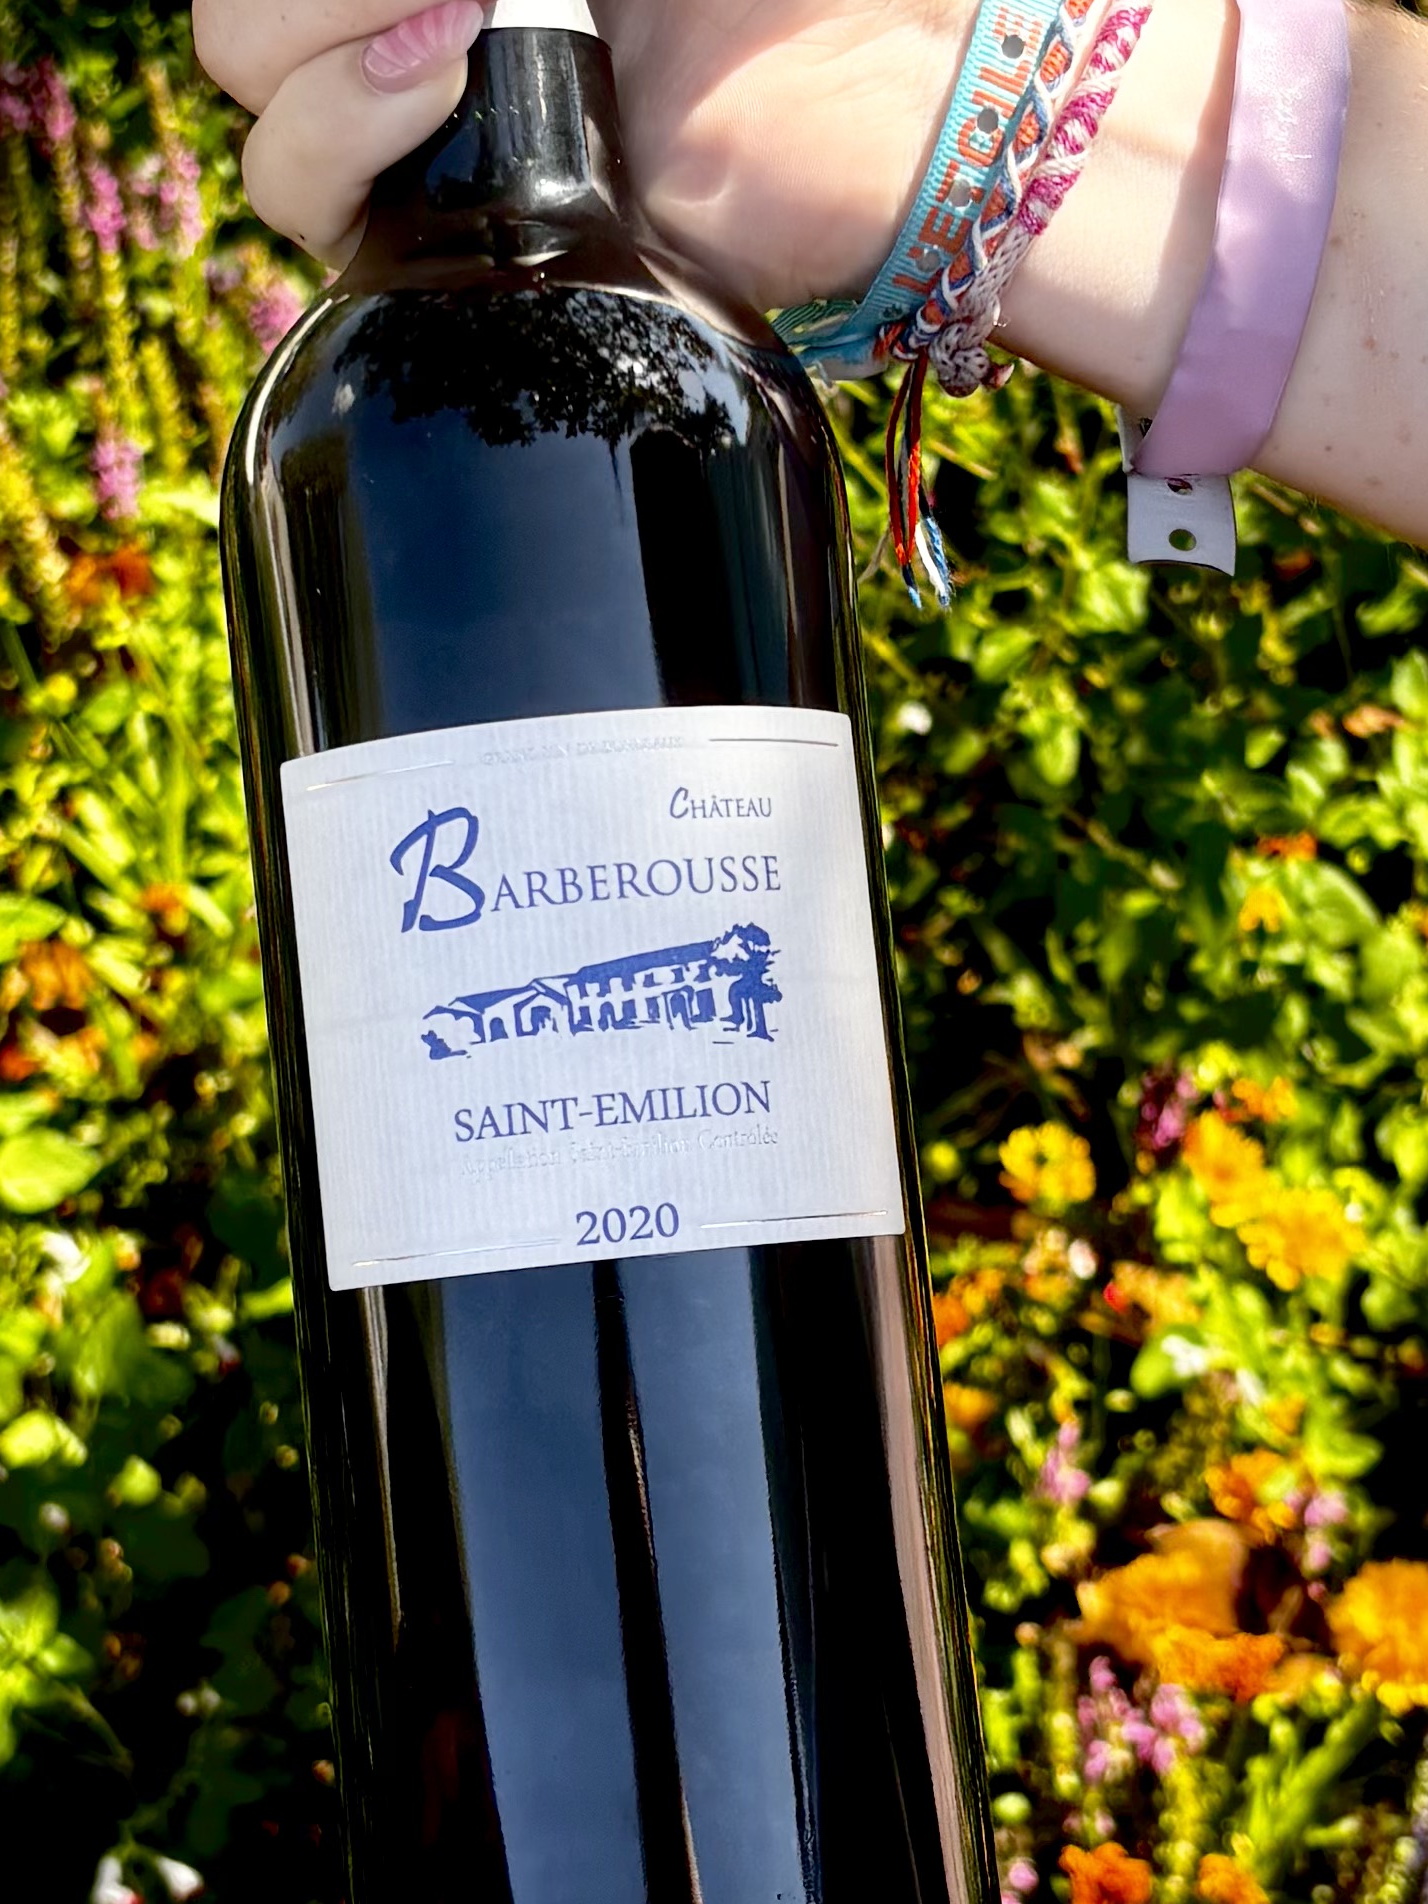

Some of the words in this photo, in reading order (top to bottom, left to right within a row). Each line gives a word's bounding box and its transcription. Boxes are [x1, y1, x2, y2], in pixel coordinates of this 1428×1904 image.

[669, 785, 773, 821] CHÂTEAU
[388, 806, 783, 934] BARBEROUSSE
[453, 1080, 772, 1145] SAINT-EMILION
[574, 1201, 682, 1247] 2020
